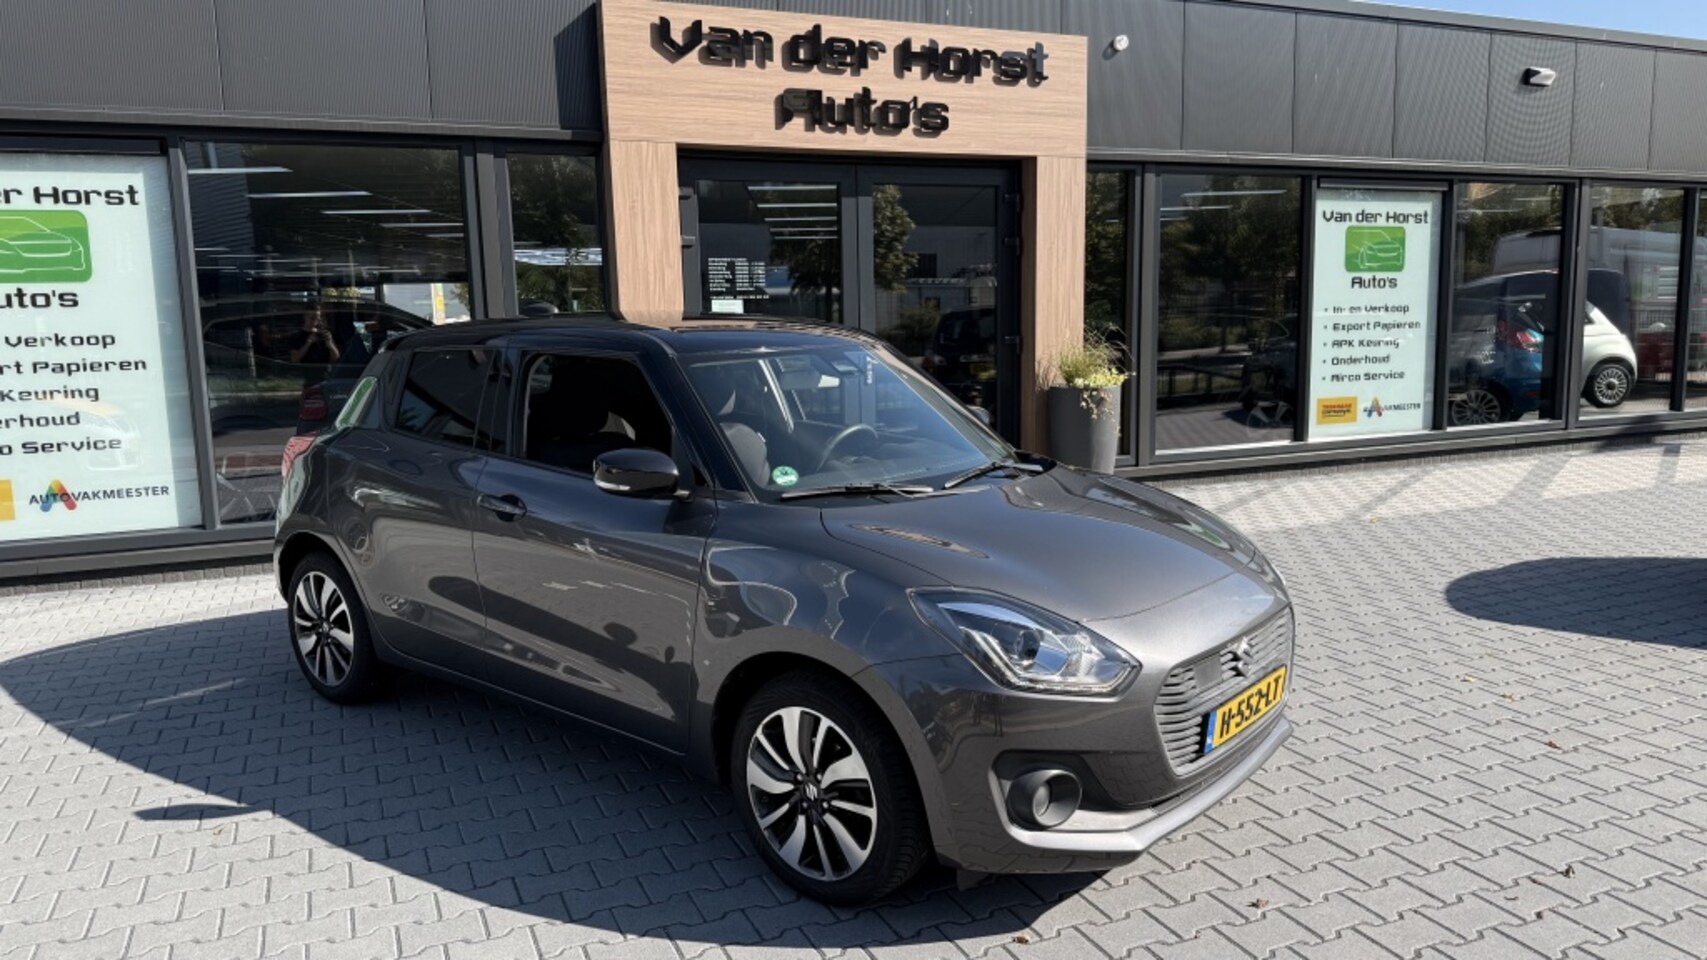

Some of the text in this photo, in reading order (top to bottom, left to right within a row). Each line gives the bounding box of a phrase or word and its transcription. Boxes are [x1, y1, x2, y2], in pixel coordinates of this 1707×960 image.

[650, 16, 1049, 88] Van der Horst
[775, 87, 949, 138] Auto's
[33, 185, 140, 206] Horst
[1322, 209, 1429, 224] Van der Horst
[1351, 275, 1398, 289] Auto's
[1332, 320, 1421, 333] Export Papieren
[1331, 339, 1355, 348] APK
[32, 358, 148, 377] Papieren
[1331, 354, 1391, 366] Onderhoud
[1363, 370, 1406, 381] Service
[0, 385, 100, 402] Keuring
[21, 437, 122, 454] Service
[29, 486, 170, 506] AUTOVAKMEESTER
[1219, 675, 1283, 739] H-552-LT
